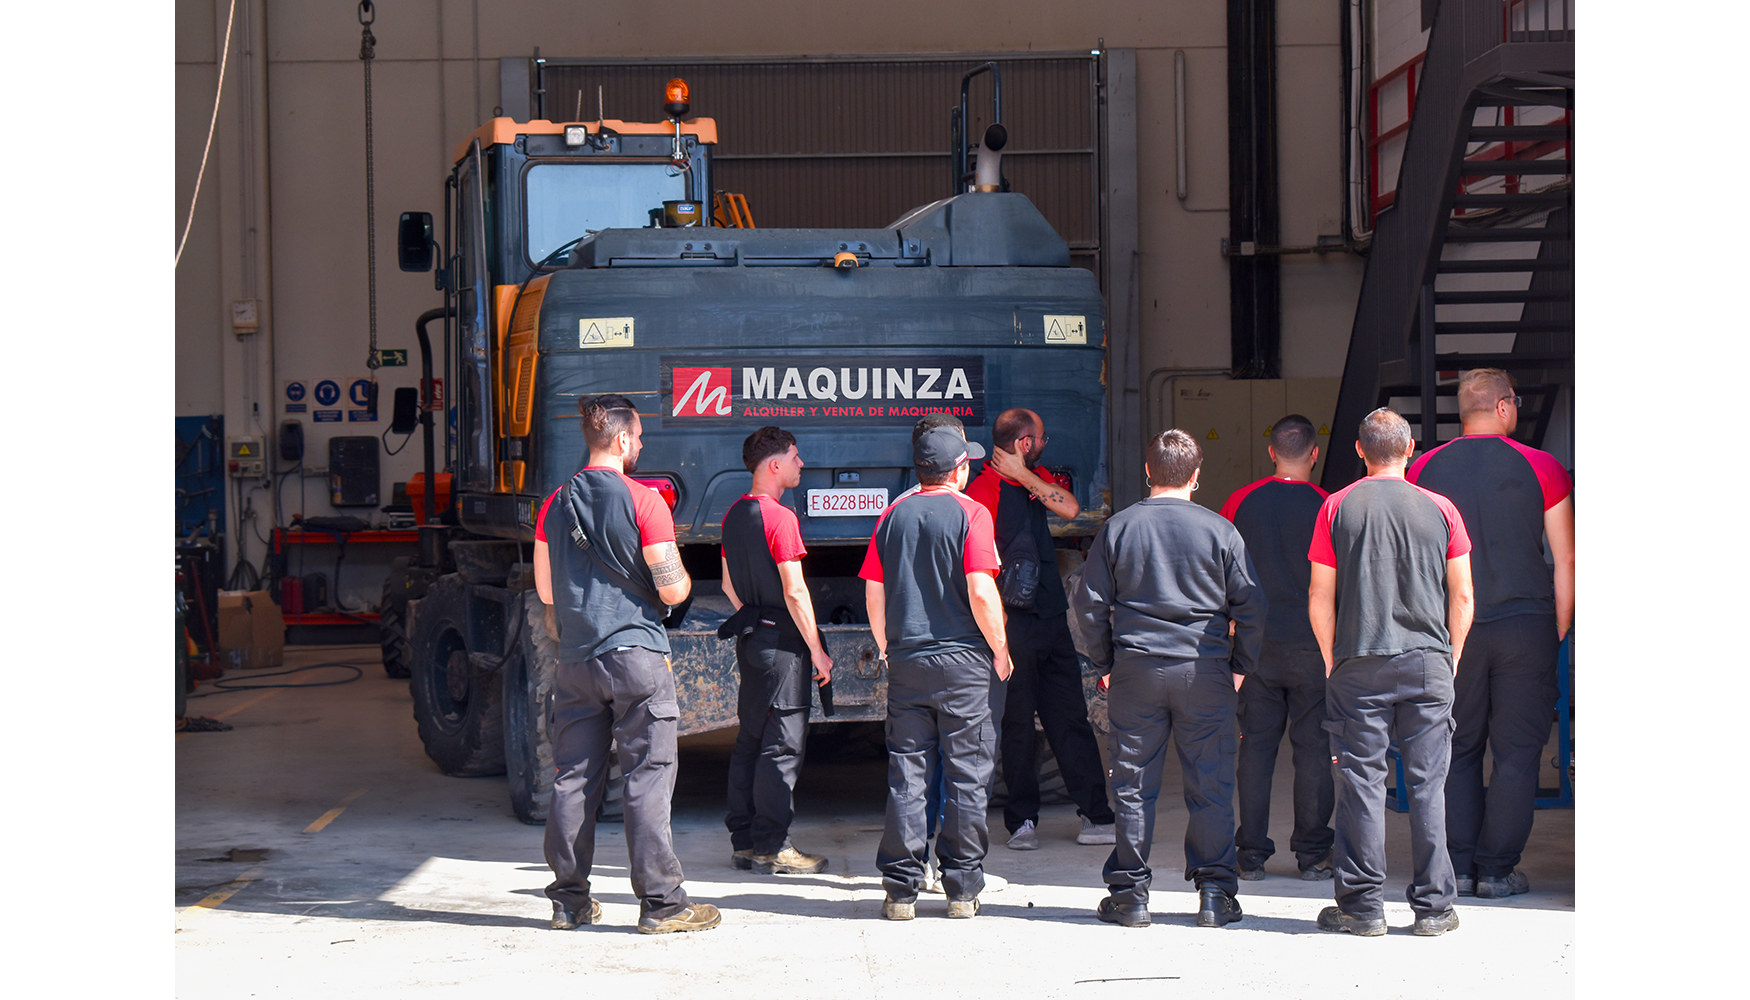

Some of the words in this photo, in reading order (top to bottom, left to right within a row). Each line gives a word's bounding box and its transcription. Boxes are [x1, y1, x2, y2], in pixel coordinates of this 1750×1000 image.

[742, 367, 974, 402] MAQUINZA
[743, 406, 805, 417] ALQUILER
[809, 407, 818, 417] Y
[822, 406, 865, 417] VENTA
[870, 406, 885, 417] DE
[888, 406, 974, 418] MAQUINARIA
[811, 495, 820, 510] E
[822, 494, 857, 510] 8228
[858, 494, 884, 510] BHG
